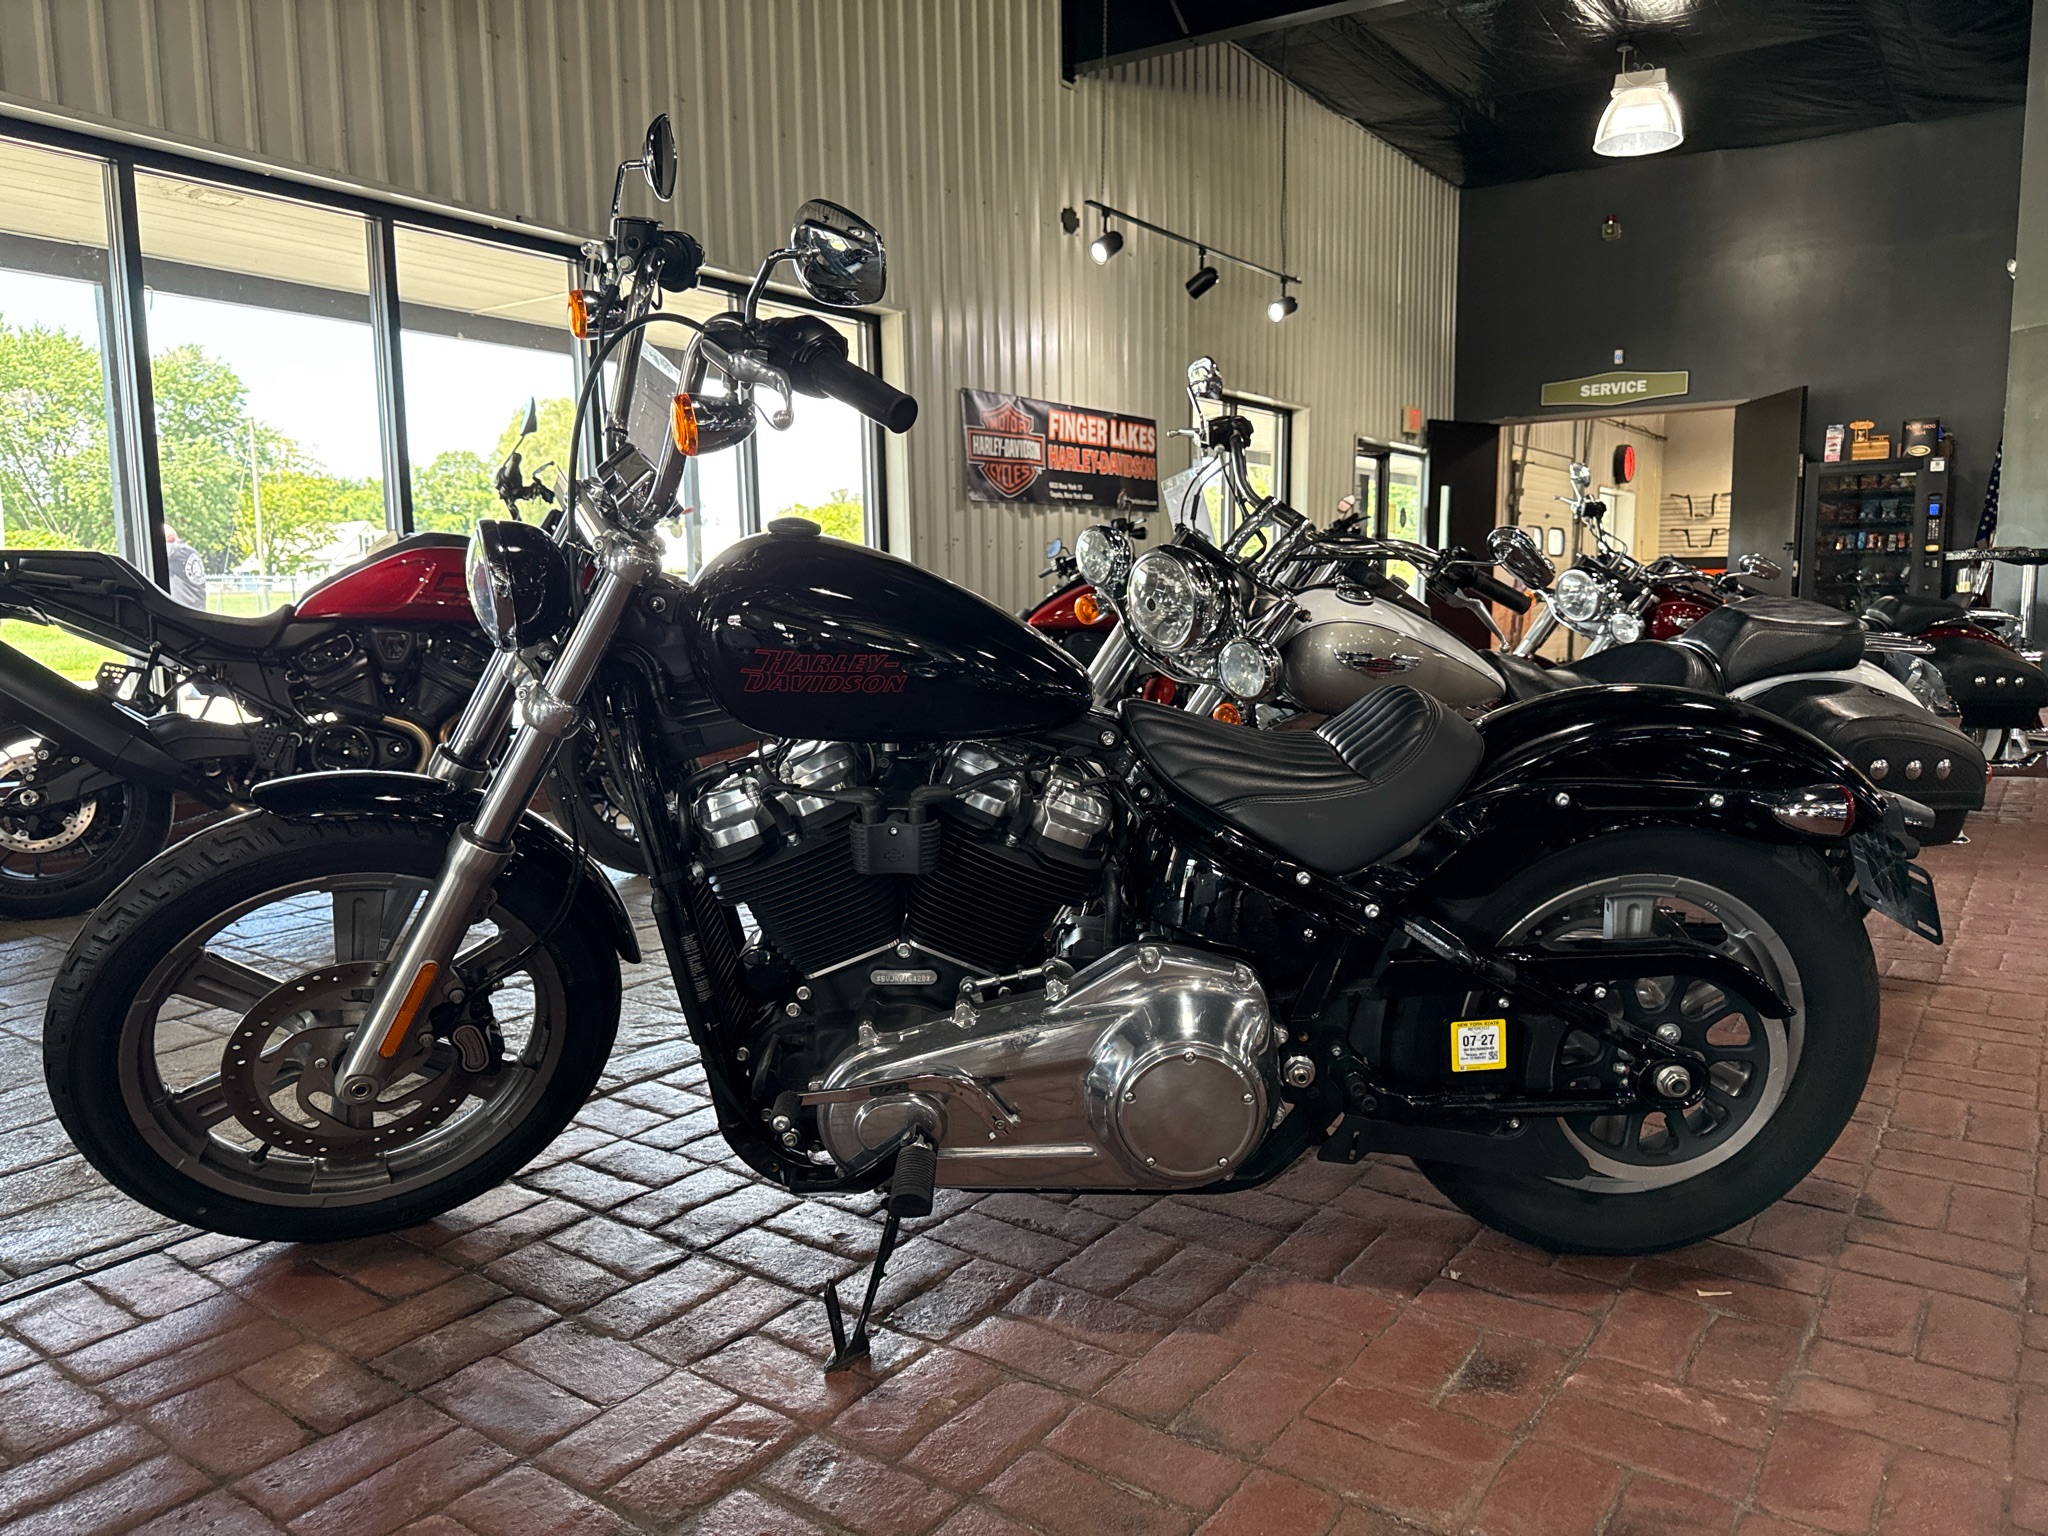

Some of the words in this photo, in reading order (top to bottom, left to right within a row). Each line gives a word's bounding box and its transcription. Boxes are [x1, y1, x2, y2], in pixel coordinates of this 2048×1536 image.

[1580, 380, 1647, 397] SERVICE
[988, 414, 1031, 434] MOTOR
[1048, 409, 1108, 447] FINGER
[1110, 419, 1156, 454] LAKES
[972, 435, 1041, 460] HARLEY-DAVIDSON
[1047, 444, 1156, 480] HARLEY-DAVIDSON
[990, 464, 1031, 487] CYCLES
[755, 650, 899, 674] HARLEY-
[741, 668, 908, 693] DAVIDSON
[1463, 1035, 1476, 1046] 07
[1481, 1034, 1495, 1046] 27
